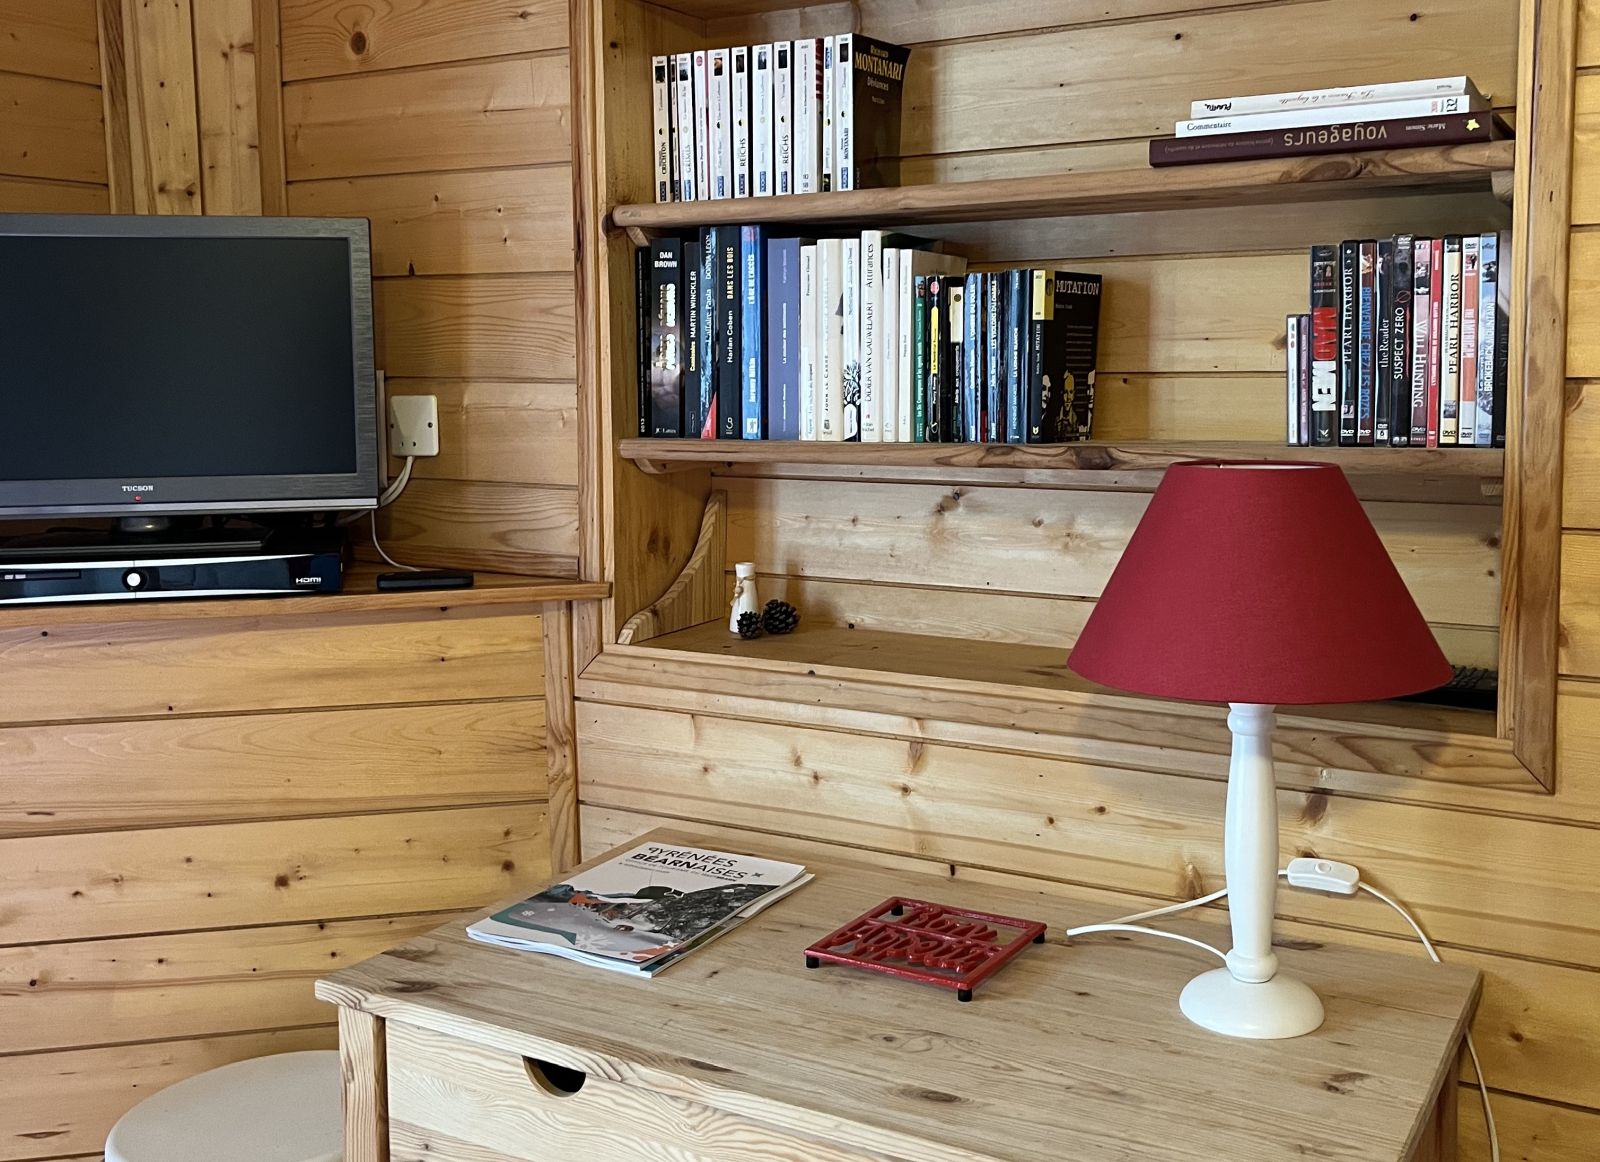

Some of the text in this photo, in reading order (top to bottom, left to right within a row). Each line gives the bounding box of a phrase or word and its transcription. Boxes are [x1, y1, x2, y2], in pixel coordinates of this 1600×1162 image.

[854, 51, 904, 80] MONTANARI
[1186, 122, 1232, 131] Commentaire
[1284, 123, 1388, 147] voyageurs
[654, 260, 678, 268] BROWN
[660, 251, 674, 260] DAN
[726, 247, 734, 264] BOIS
[864, 244, 874, 289] Attirances
[726, 265, 734, 278] LES
[726, 280, 734, 300] DANS
[1056, 280, 1100, 296] MUTATION
[865, 302, 873, 356] CAUWELAERT
[1343, 268, 1353, 362] PEARL HARBOR
[1448, 273, 1460, 374] PEARL HARBOR
[1312, 306, 1337, 360] MAD
[1394, 306, 1404, 380] SUSPECT ZERO
[1484, 302, 1496, 392] BROKEBACK MOUNTAIN
[865, 357, 873, 375] VAN
[1360, 286, 1371, 419] BIENVENUE CHEZ LES ROZES
[1413, 320, 1428, 408] WILL HUNTING
[1312, 360, 1337, 412] MEN
[631, 853, 748, 880] BÉARNAISES
